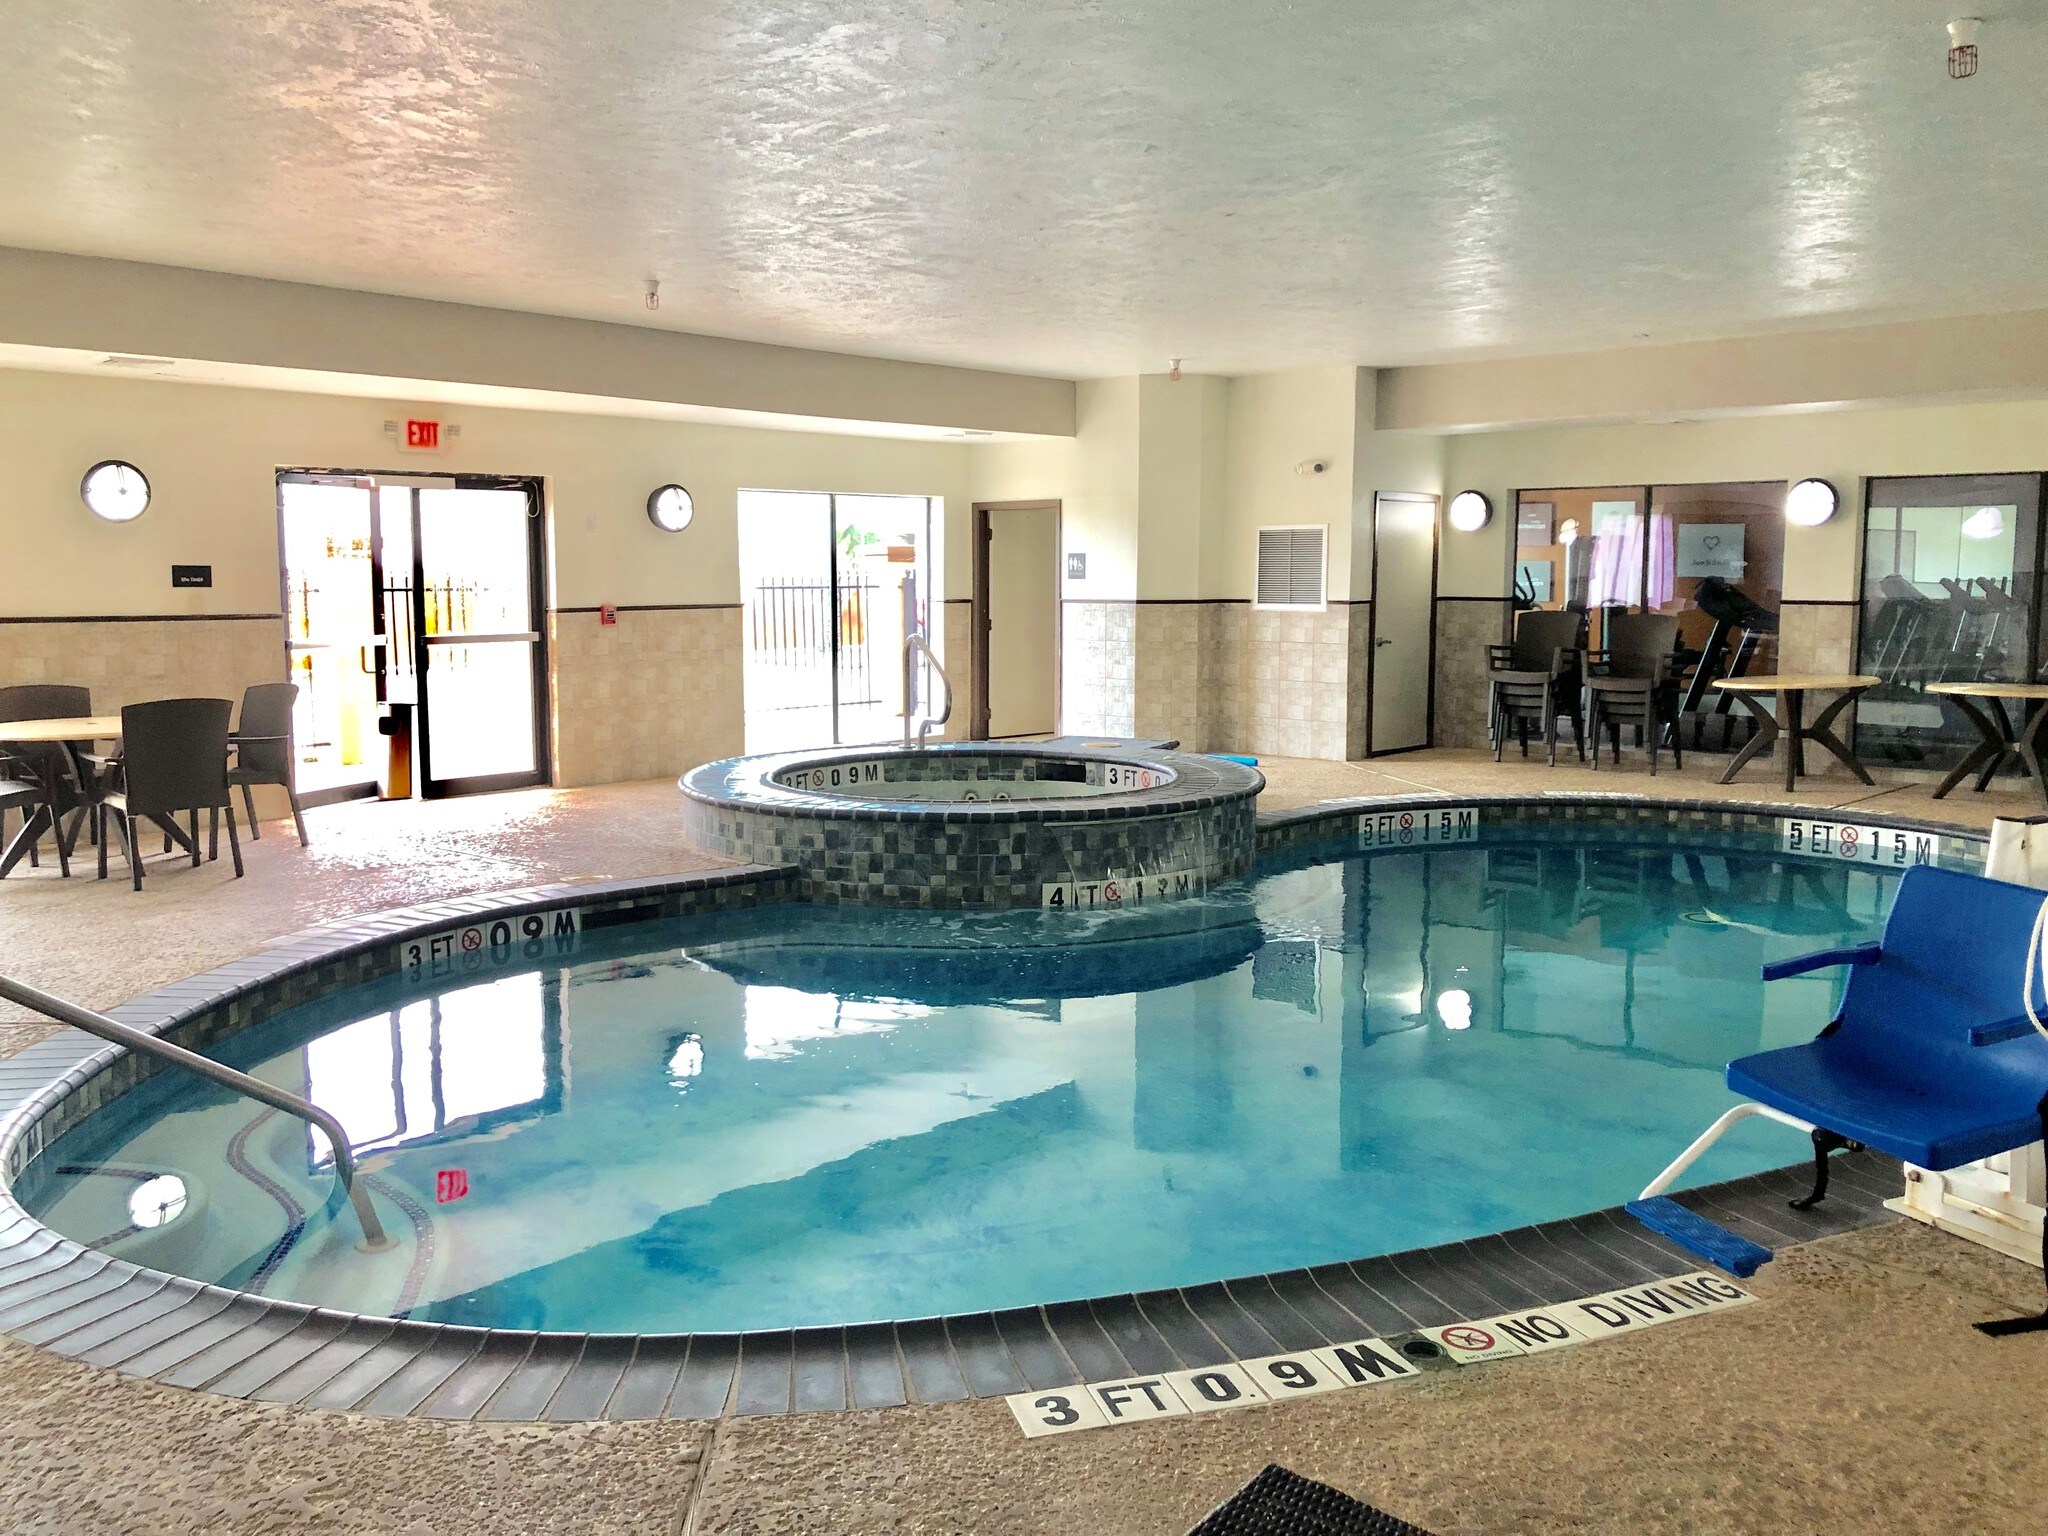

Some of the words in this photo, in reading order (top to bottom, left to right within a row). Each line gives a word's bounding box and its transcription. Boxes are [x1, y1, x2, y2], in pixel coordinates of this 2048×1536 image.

[408, 420, 438, 447] EXIT
[796, 772, 809, 791] FT
[865, 763, 878, 782] M
[1109, 767, 1118, 785] 3
[1124, 769, 1138, 787] FT
[1050, 887, 1065, 906] 4
[408, 944, 422, 967] 3
[430, 935, 454, 961] FT
[553, 911, 576, 936] M
[1495, 1315, 1569, 1347] NO
[1578, 1276, 1748, 1329] DIVING
[1034, 1395, 1080, 1426] 3
[1096, 1380, 1168, 1418] FT
[1333, 1344, 1409, 1383] M
